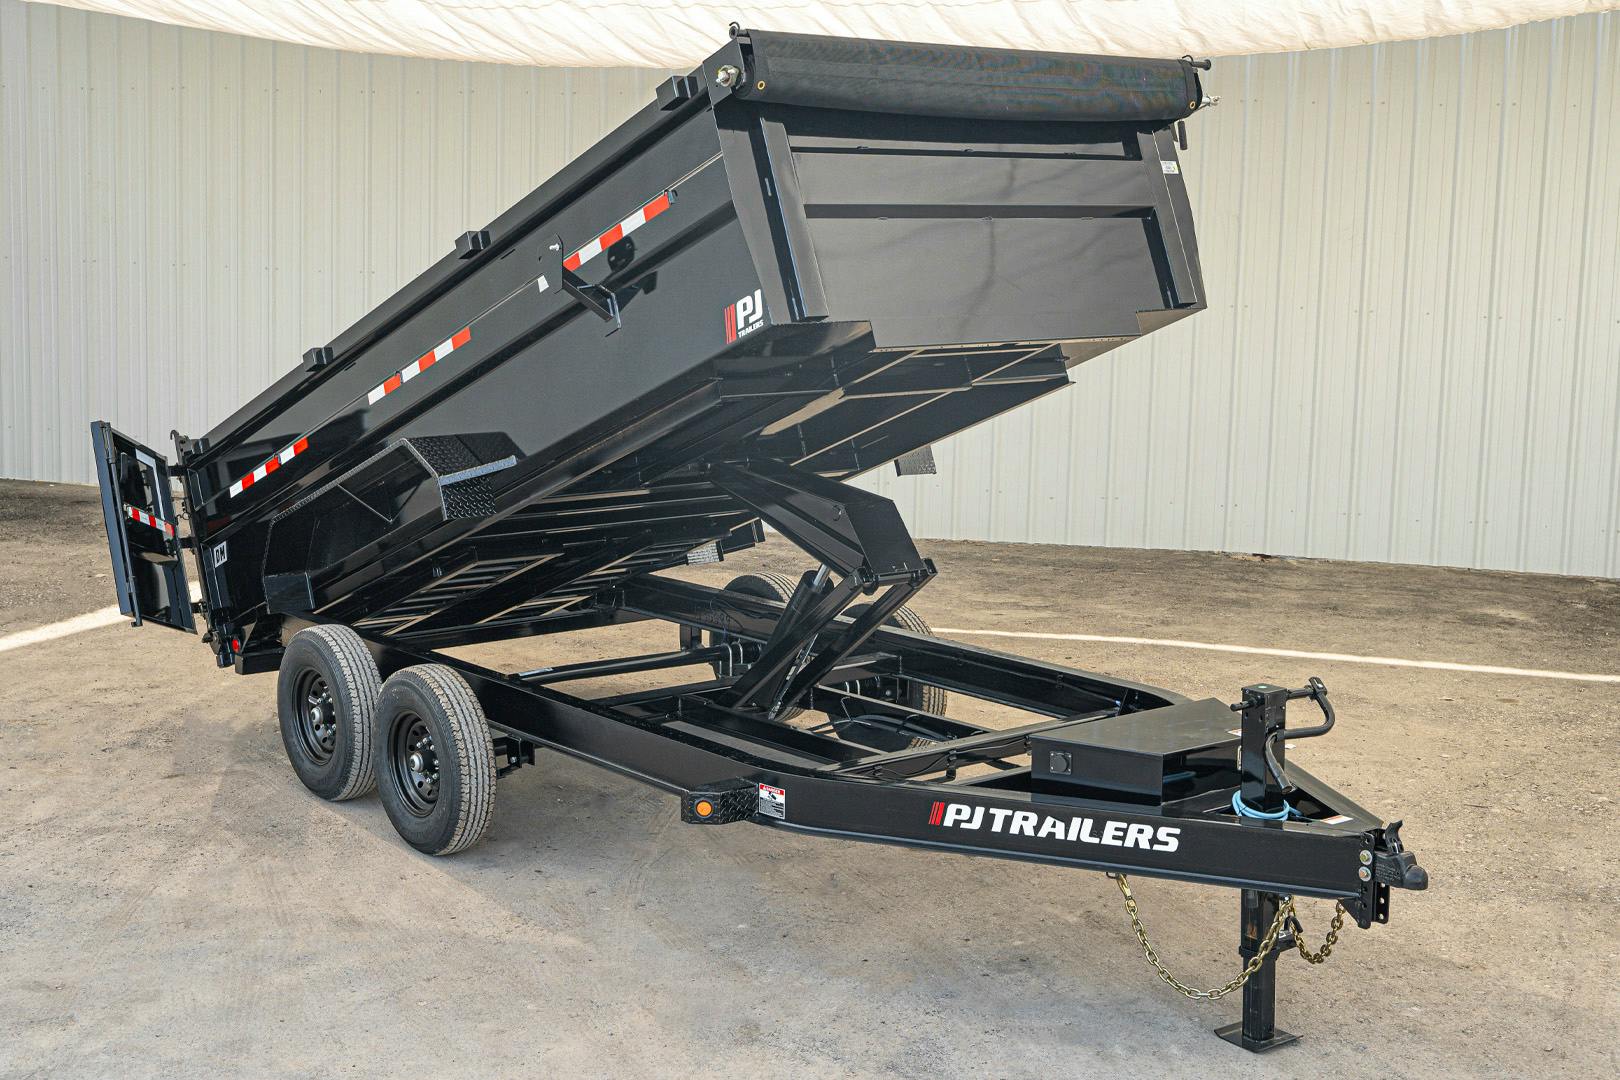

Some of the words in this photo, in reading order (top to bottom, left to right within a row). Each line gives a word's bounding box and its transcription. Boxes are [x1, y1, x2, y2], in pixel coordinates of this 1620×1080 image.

[736, 289, 763, 330] PJ
[737, 319, 764, 338] TRAILERS
[943, 803, 985, 830] PJ
[989, 808, 1181, 853] TRAILERS
